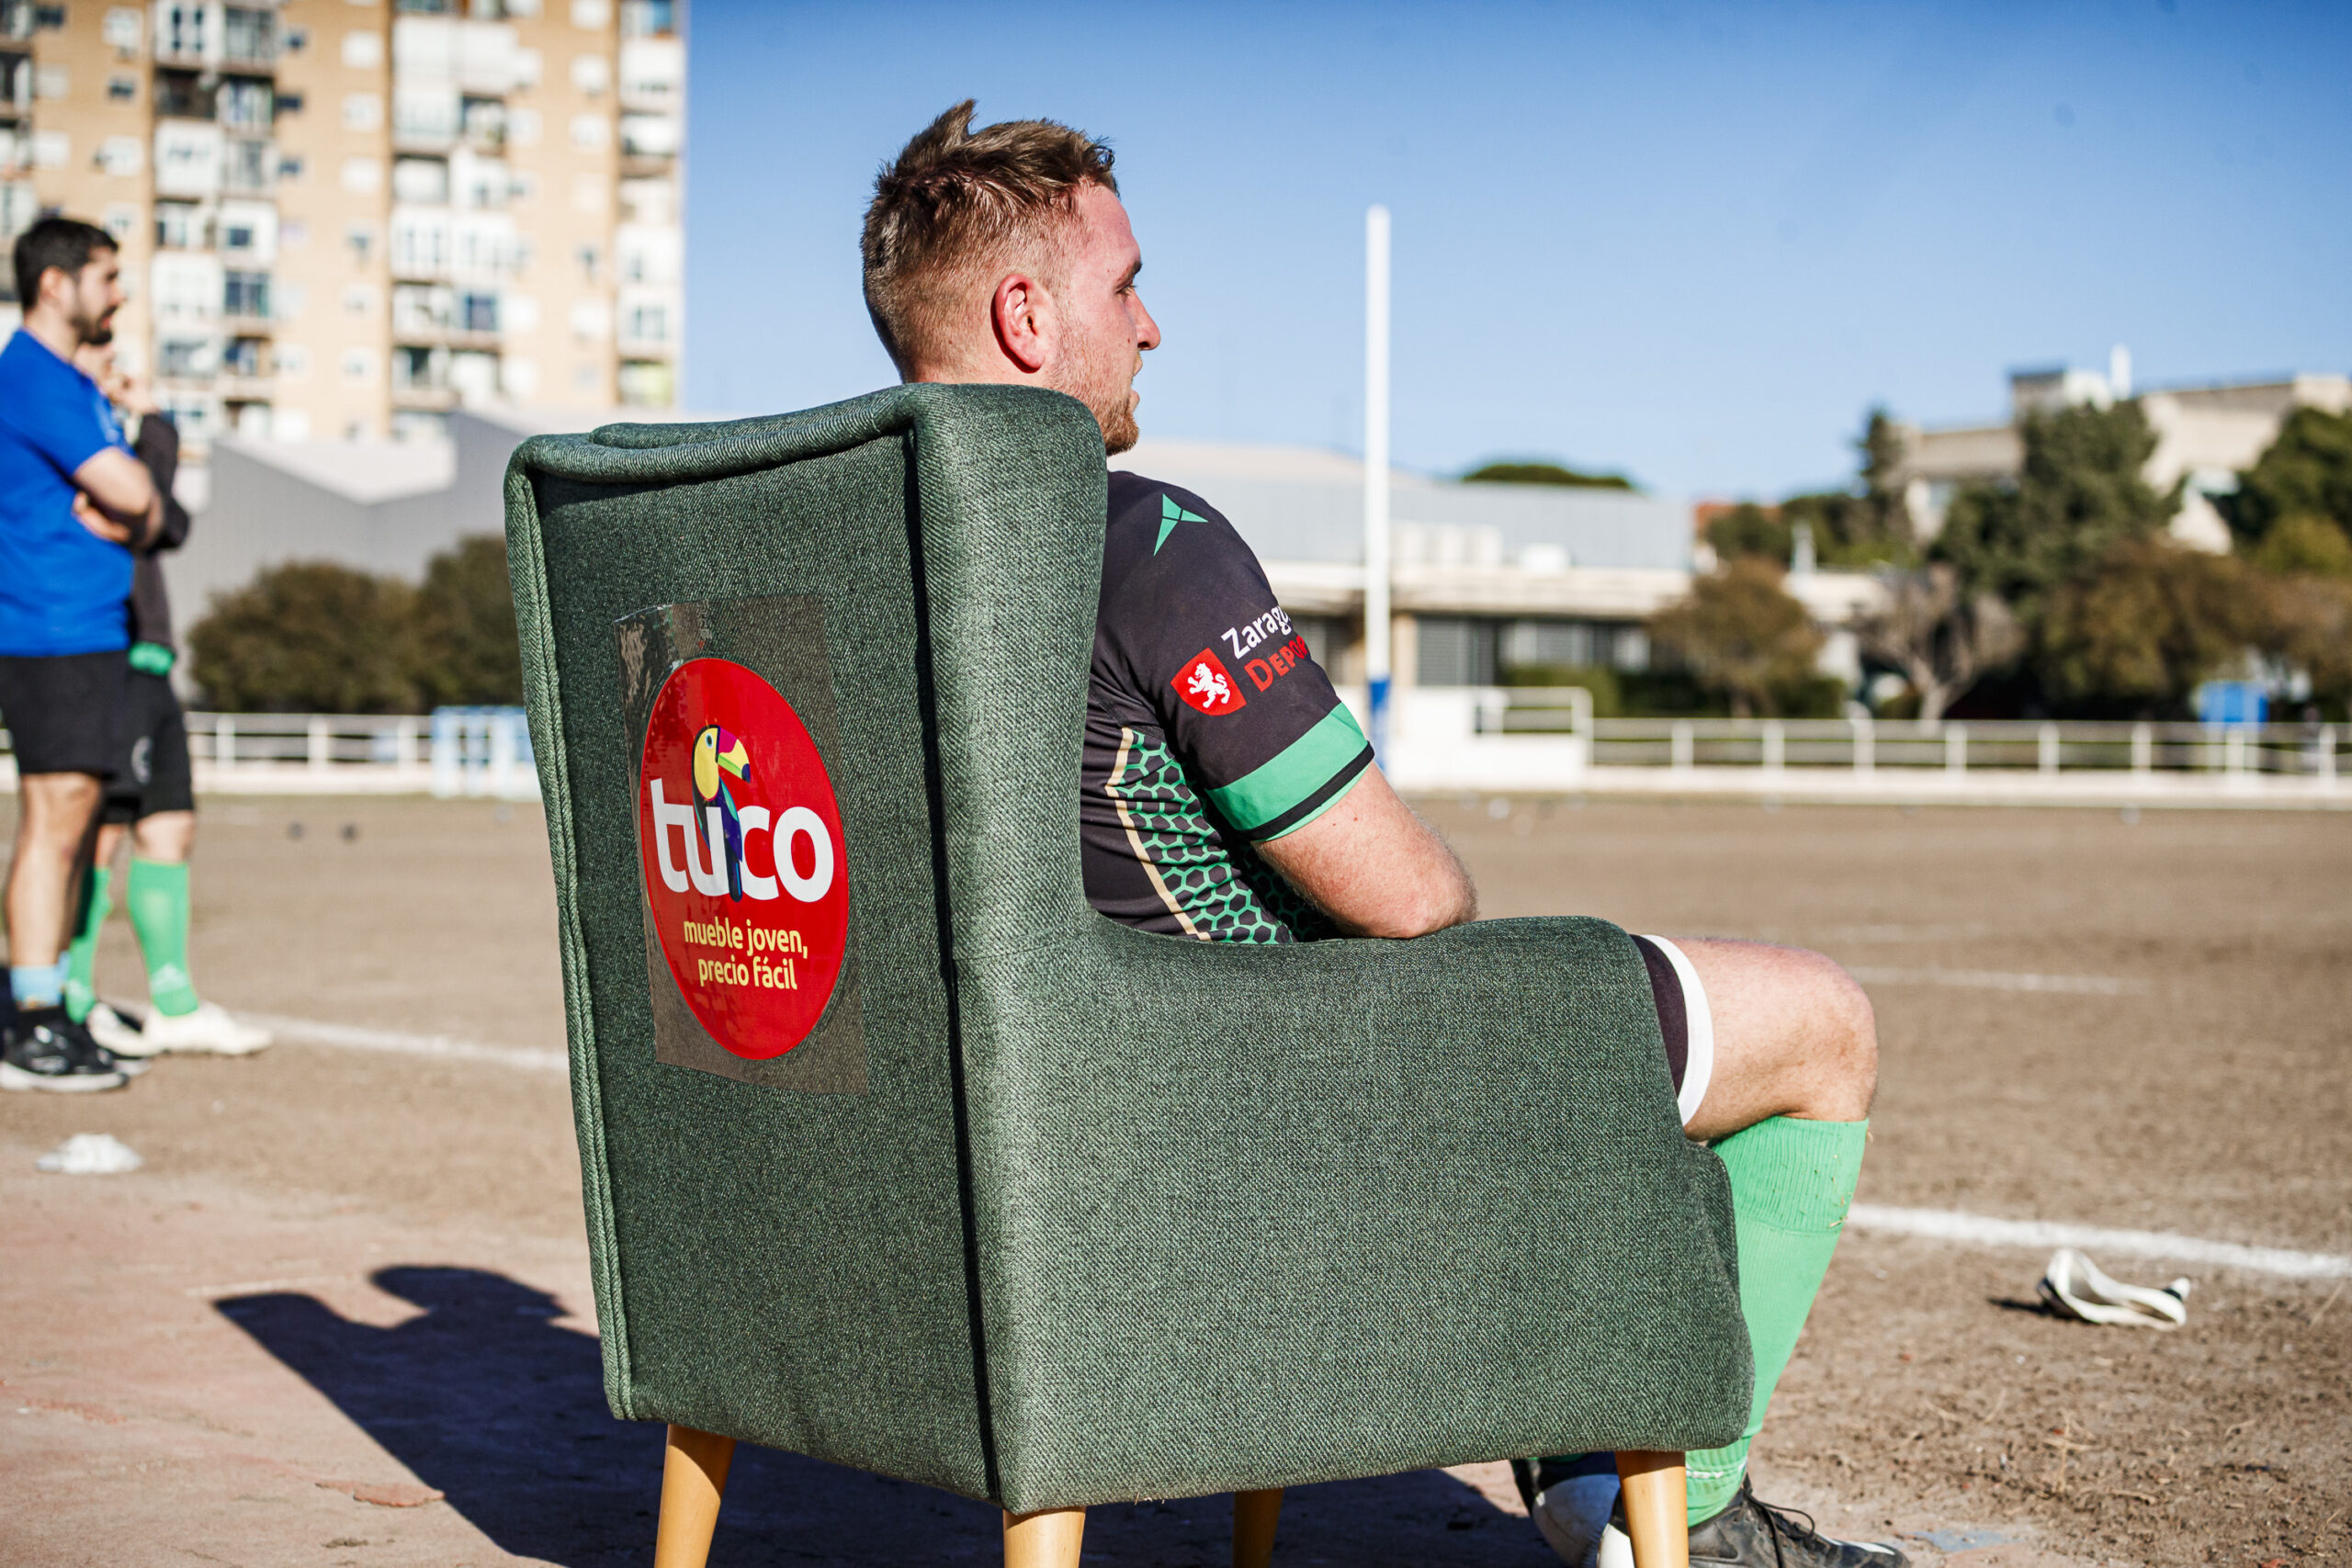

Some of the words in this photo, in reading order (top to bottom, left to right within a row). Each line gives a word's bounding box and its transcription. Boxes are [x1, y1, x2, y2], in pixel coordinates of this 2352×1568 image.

[650, 778, 834, 902] tuco
[684, 916, 743, 950] mueble
[746, 919, 808, 959] joven,
[698, 954, 749, 987] precio
[752, 955, 797, 990] fácil
